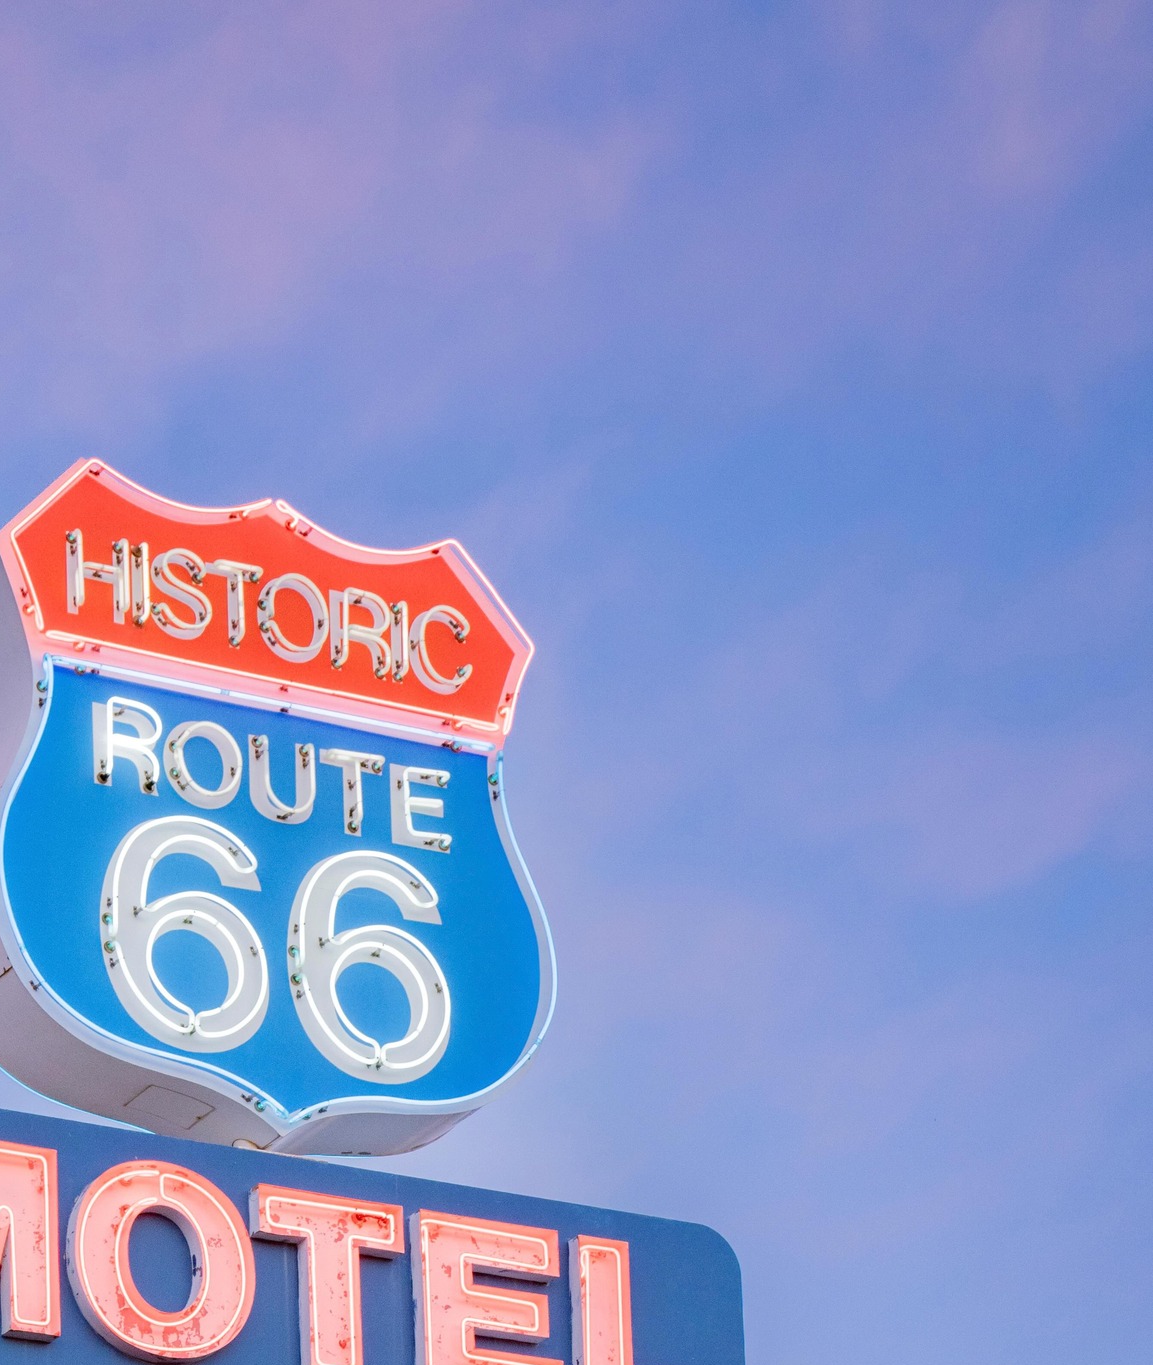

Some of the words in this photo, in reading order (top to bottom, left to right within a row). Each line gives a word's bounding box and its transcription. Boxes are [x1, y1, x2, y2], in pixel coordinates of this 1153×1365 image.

[65, 529, 472, 694] HISTORIC
[91, 697, 451, 853] ROUTE
[99, 816, 451, 1084] 66
